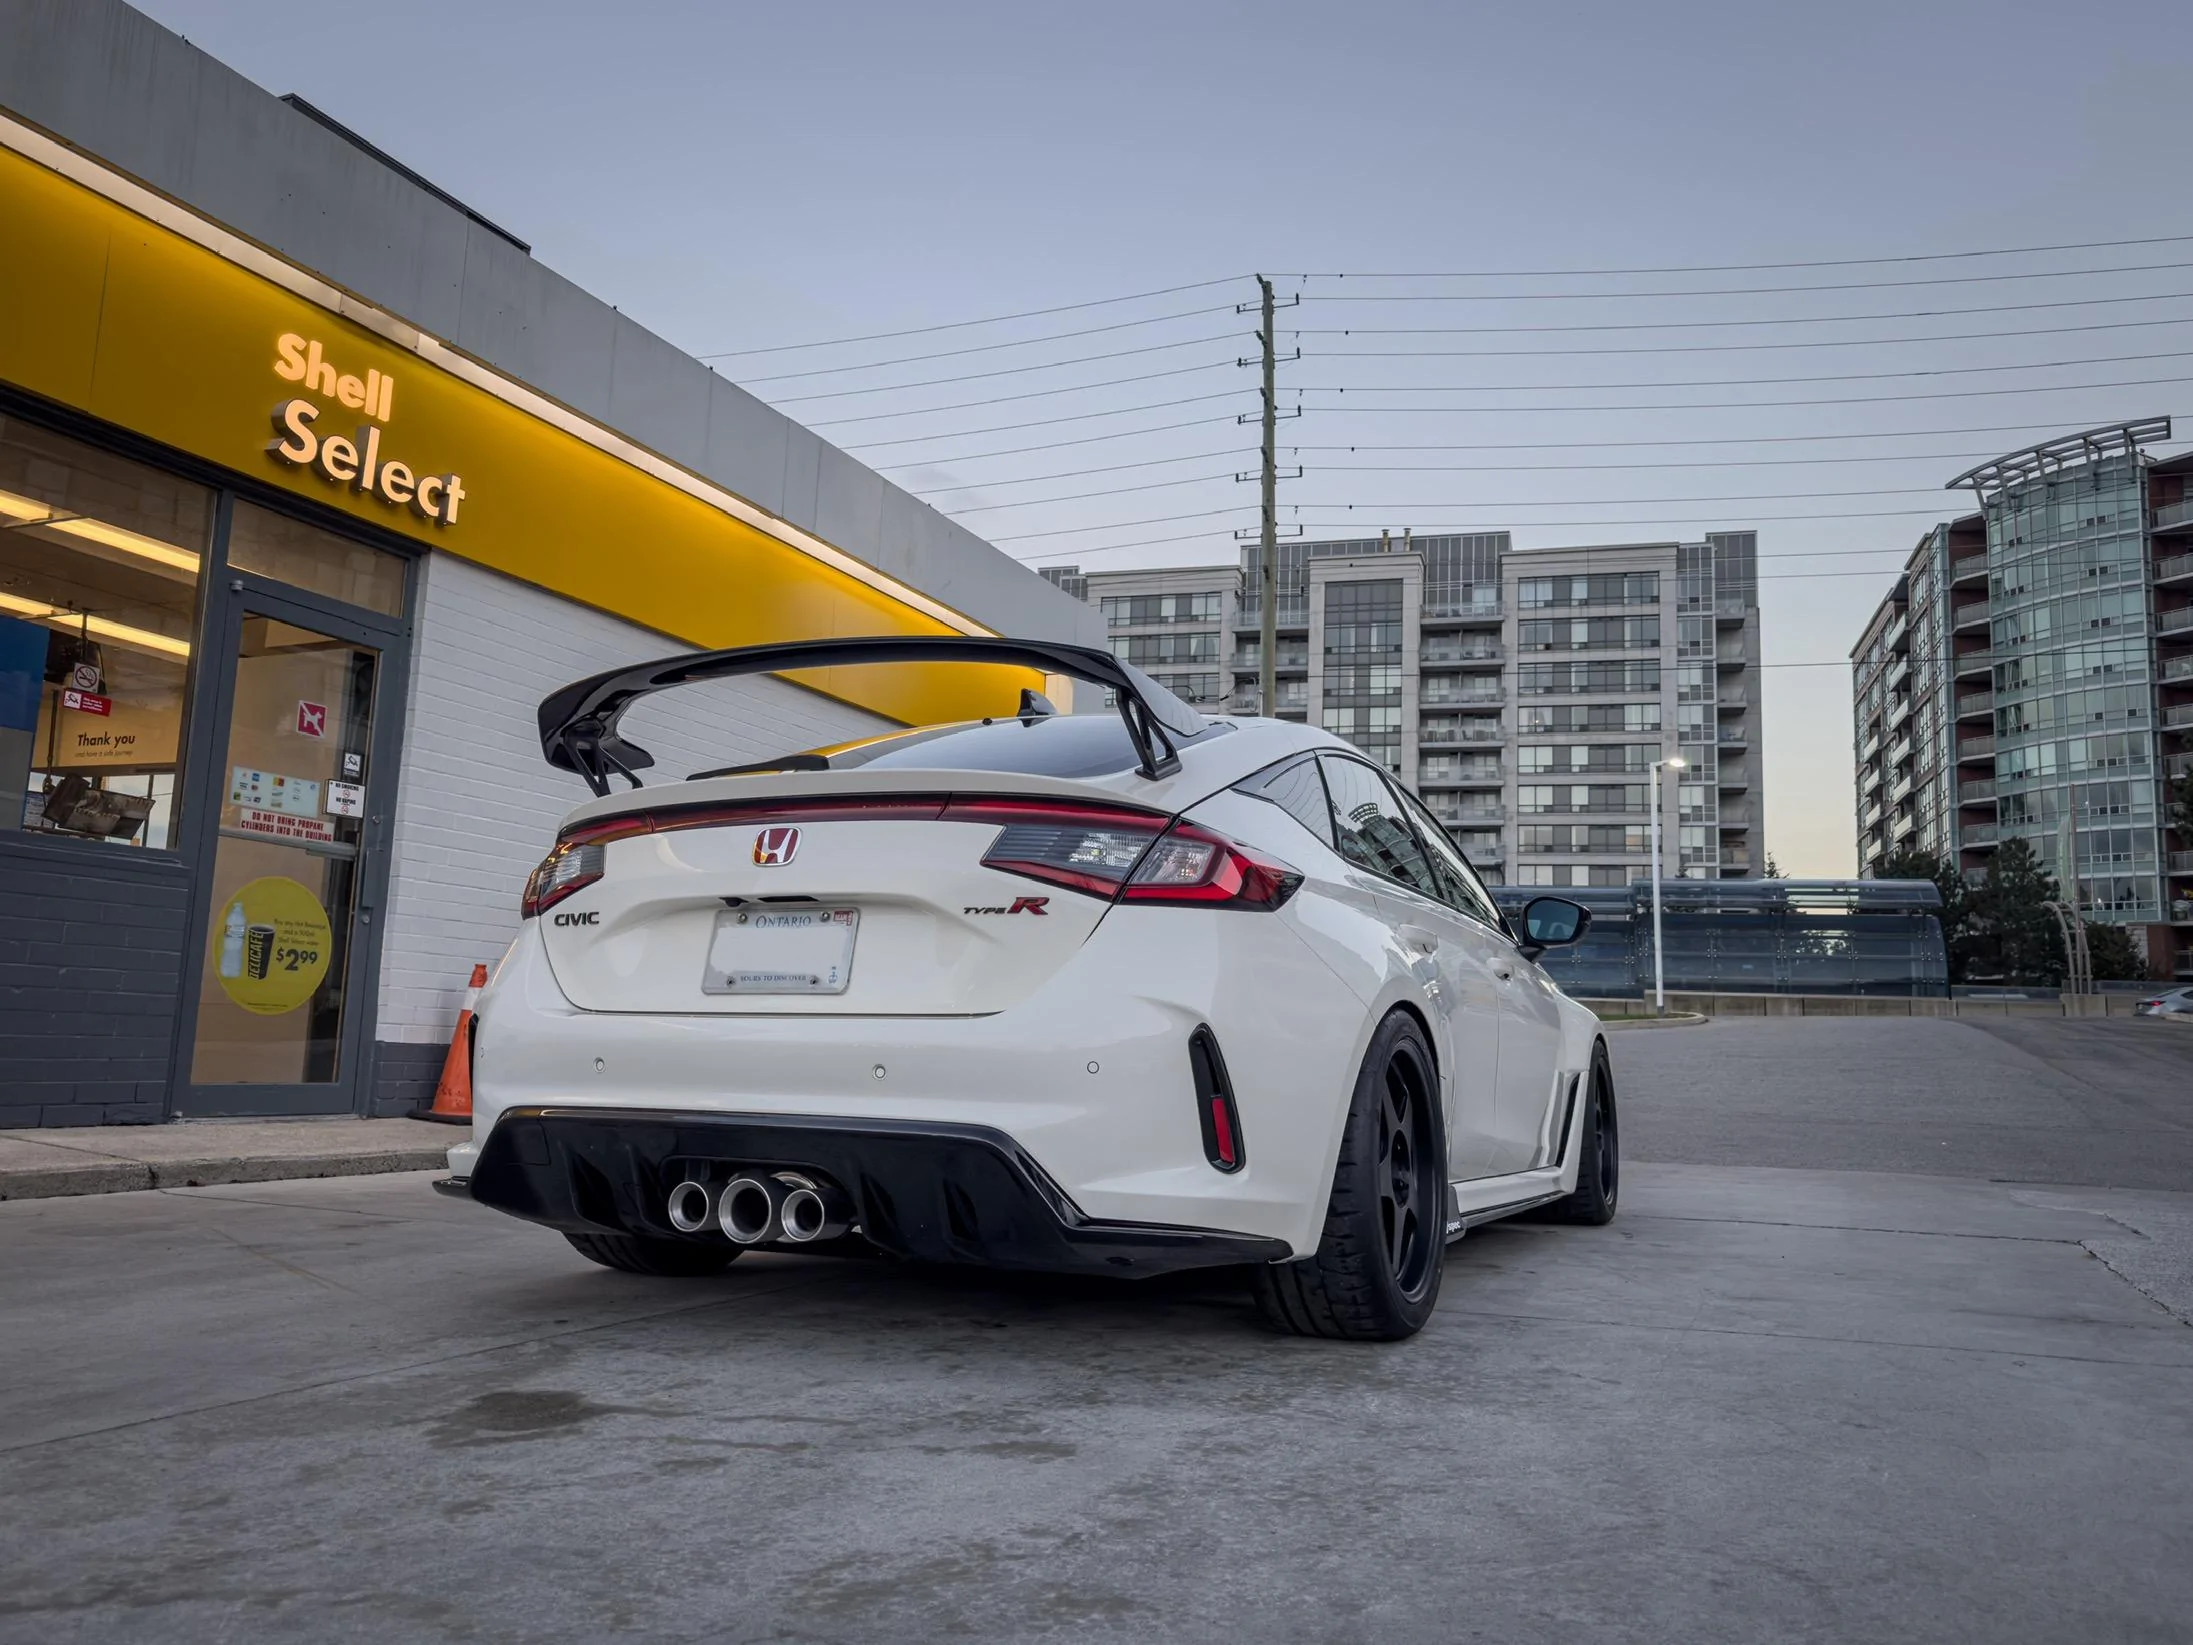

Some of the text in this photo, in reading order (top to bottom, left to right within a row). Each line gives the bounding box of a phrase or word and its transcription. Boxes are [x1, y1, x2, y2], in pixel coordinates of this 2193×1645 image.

[274, 333, 394, 422] Shell
[275, 398, 466, 525] Select
[78, 731, 136, 749] Thank you
[241, 820, 332, 842] CYLINDERS INTO THE BUILDING
[252, 811, 324, 831] DO NOT BRING PROPANE
[963, 897, 1050, 915] TYPE R
[554, 912, 600, 926] CIVIC
